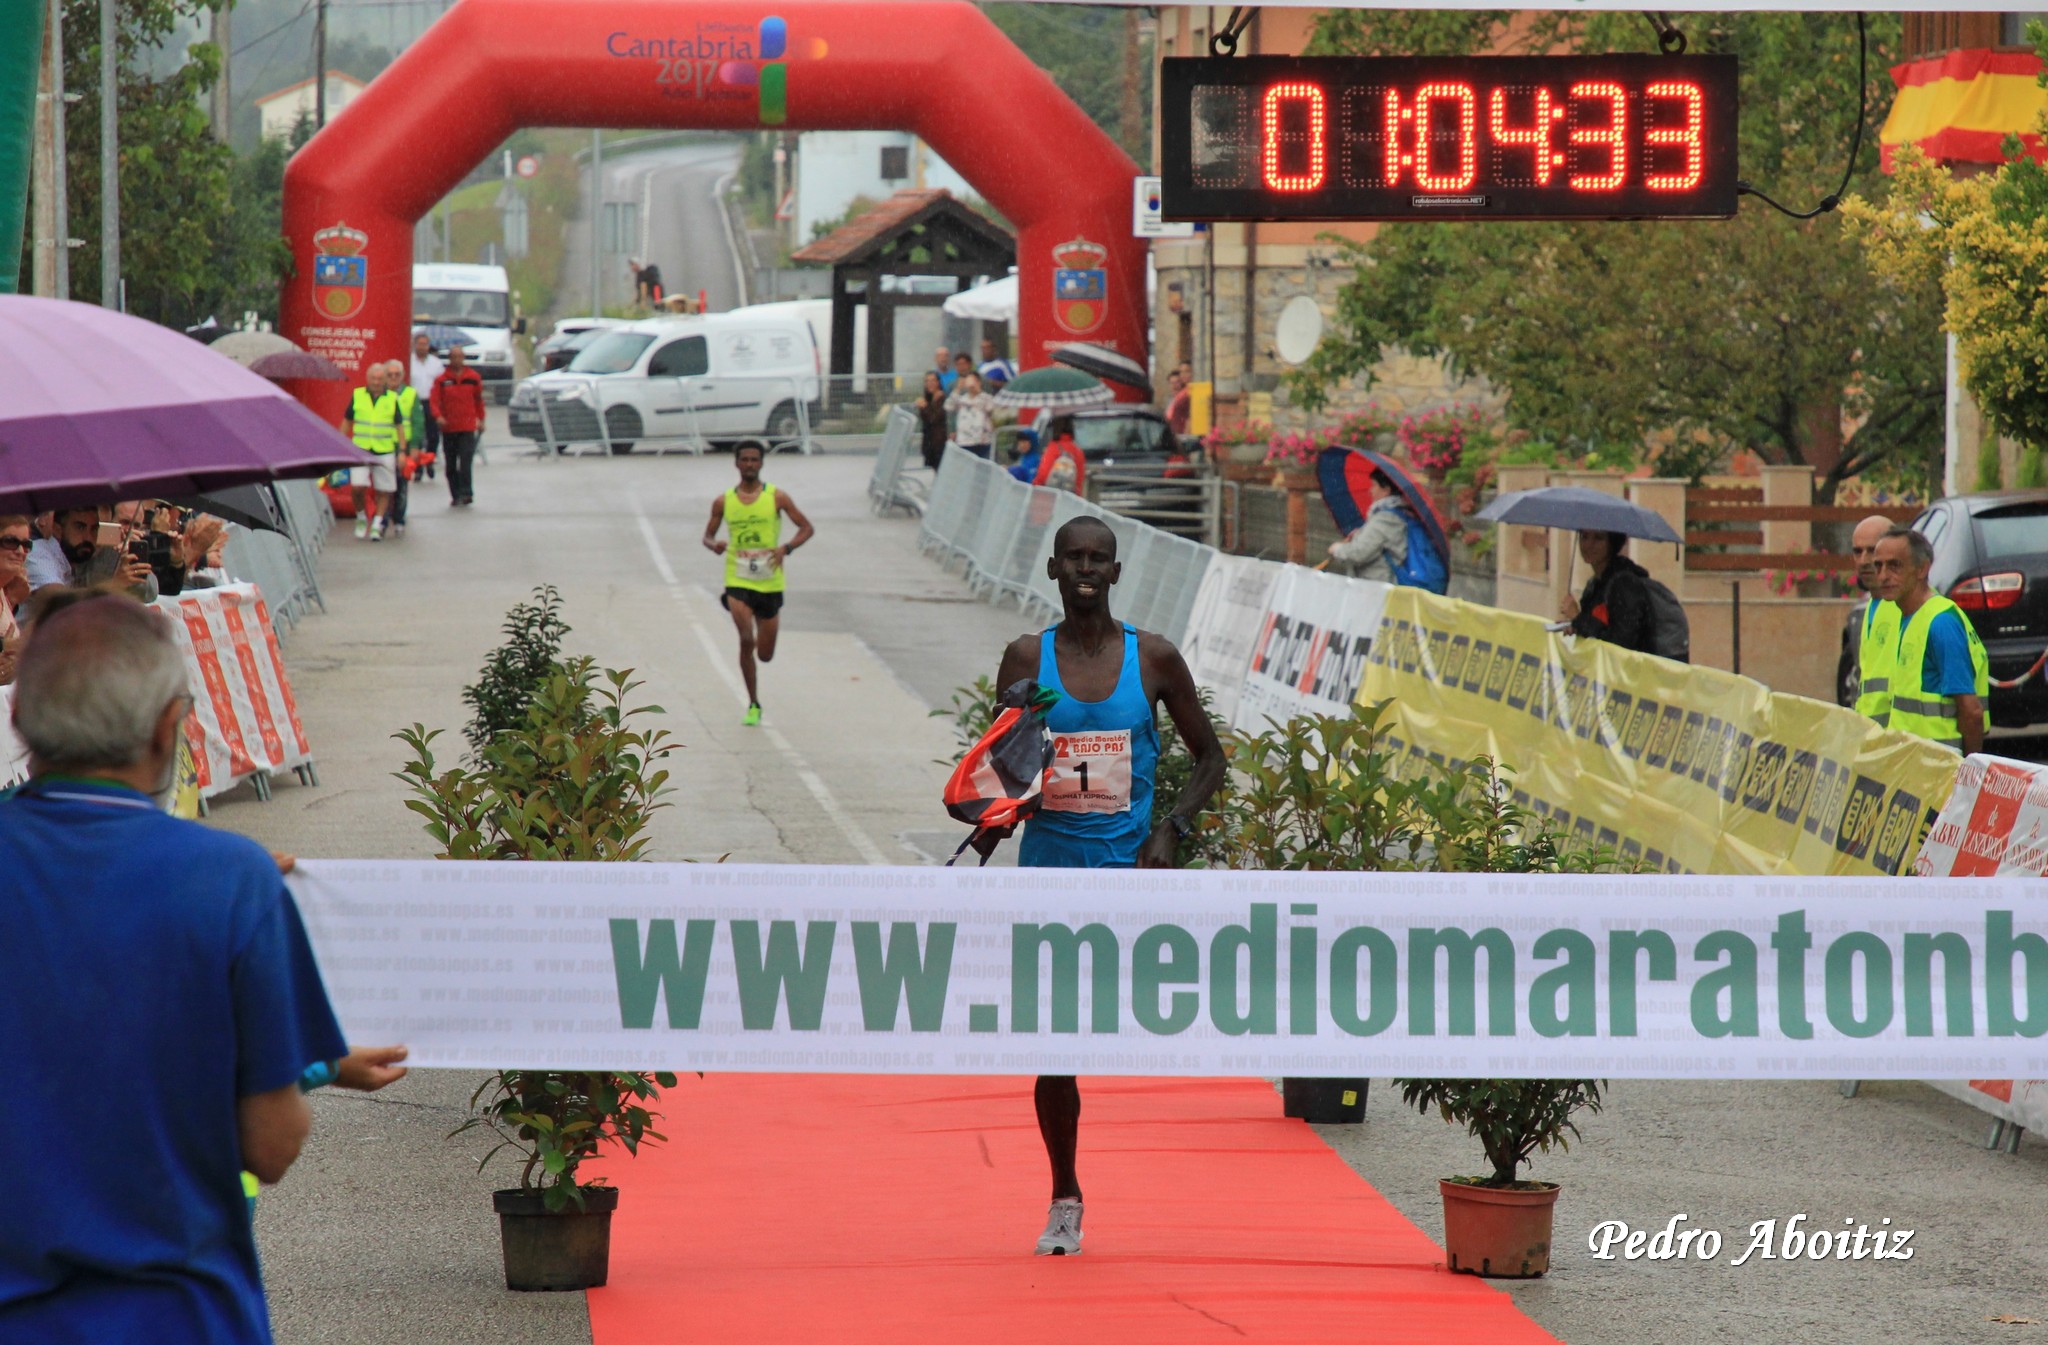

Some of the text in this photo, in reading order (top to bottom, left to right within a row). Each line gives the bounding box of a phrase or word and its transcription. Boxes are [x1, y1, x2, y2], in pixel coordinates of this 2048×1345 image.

[606, 31, 752, 59] Cantabria
[655, 59, 719, 99] 2017
[1262, 79, 1705, 192] 0 1:04:33
[750, 559, 758, 572] 6
[1054, 737, 1069, 758] 2
[1069, 736, 1093, 744] Medio
[1073, 742, 1124, 753] BAJO PAS
[1073, 761, 1088, 792] 1
[1083, 793, 1118, 801] KIPRONO
